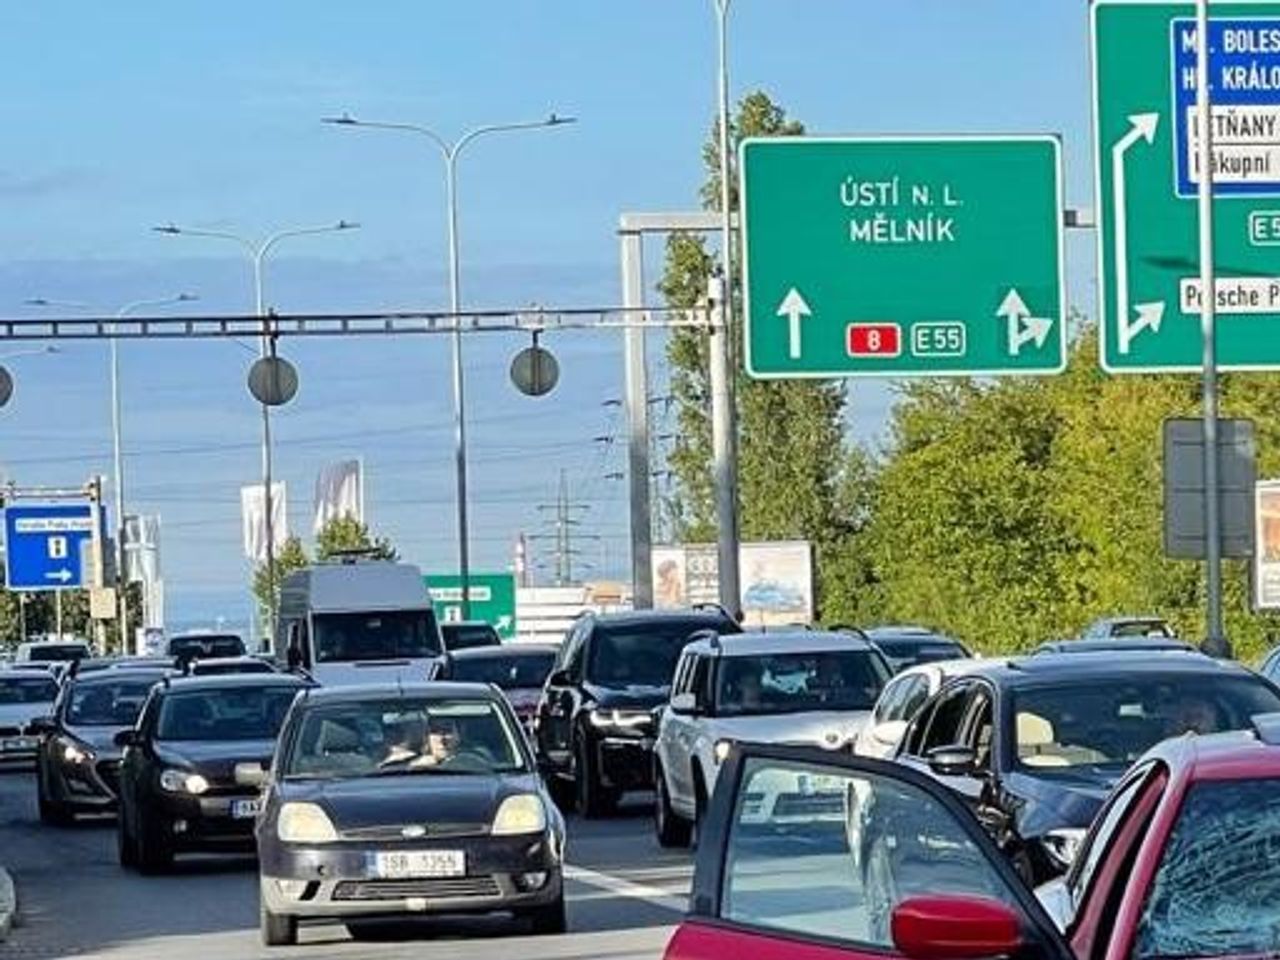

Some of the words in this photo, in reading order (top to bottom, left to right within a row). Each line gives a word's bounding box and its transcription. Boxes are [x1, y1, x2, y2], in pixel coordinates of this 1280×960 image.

[1182, 29, 1215, 54] M.
[1182, 66, 1214, 90] H.
[1193, 109, 1276, 137] TŇANY
[1195, 150, 1270, 178] kupní
[840, 176, 899, 206] ÚSTÍ
[912, 185, 934, 206] N.
[851, 212, 954, 242] MĚLNÍK
[1186, 285, 1259, 307] Psche
[867, 331, 881, 351] 8
